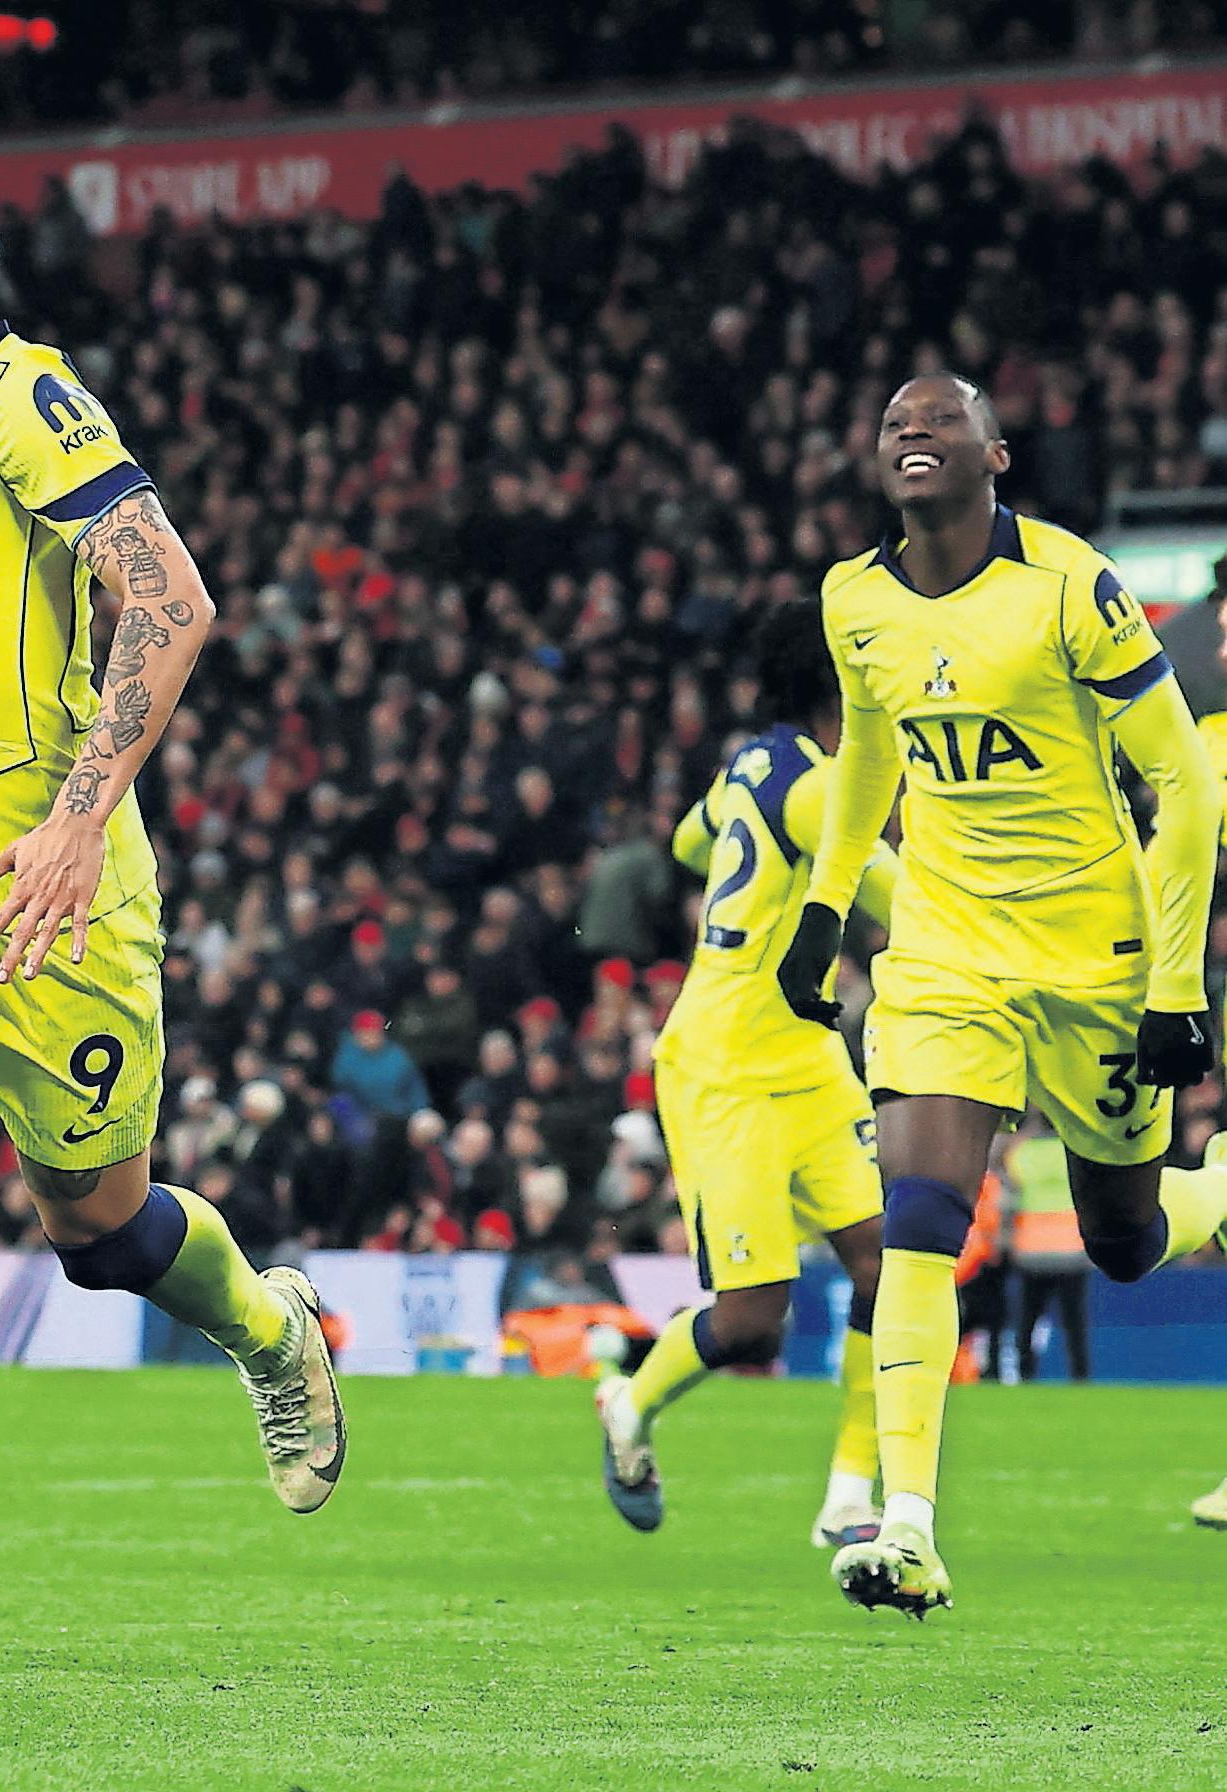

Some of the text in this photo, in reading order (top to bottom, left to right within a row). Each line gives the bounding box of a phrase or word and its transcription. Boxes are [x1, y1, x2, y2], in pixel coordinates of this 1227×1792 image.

[898, 718, 1044, 782] AIA
[69, 1033, 124, 1115] 9
[1095, 1053, 1162, 1117] 3
